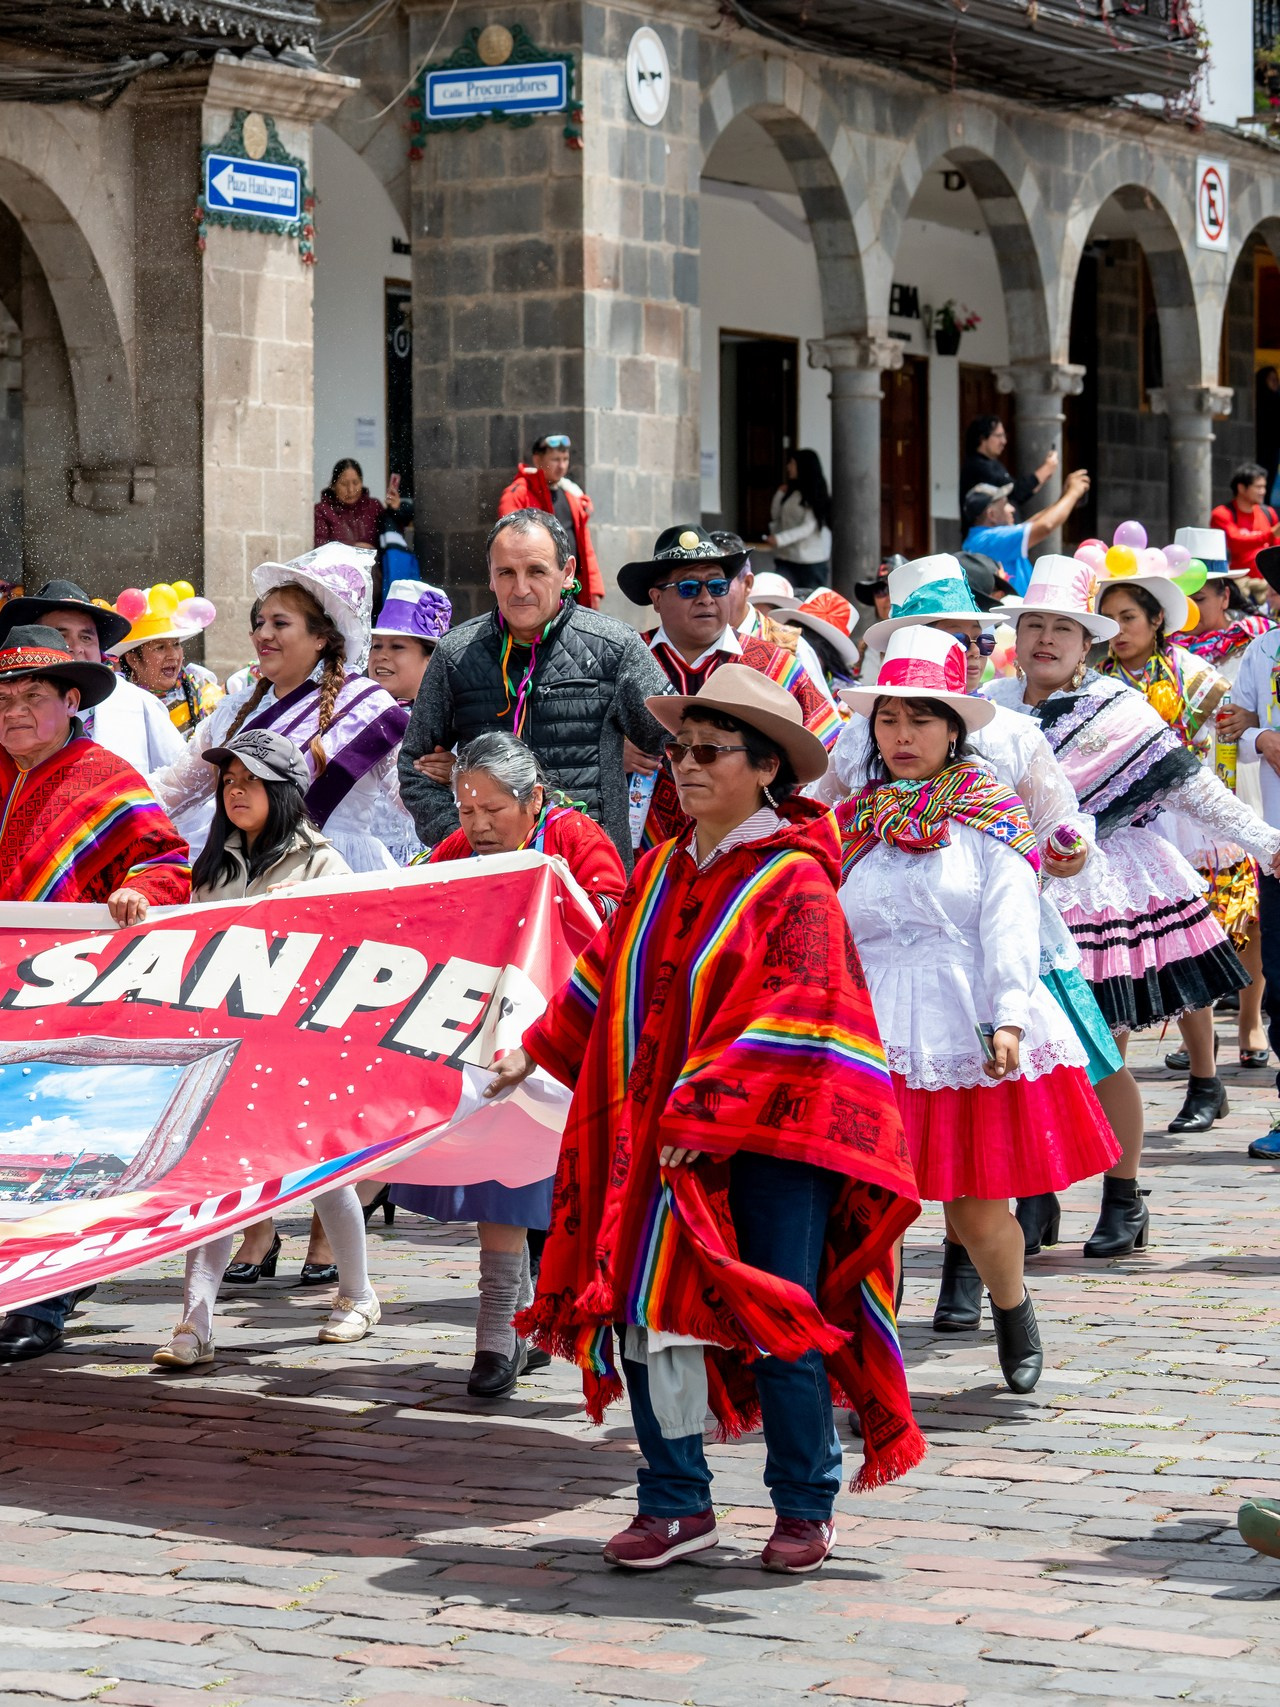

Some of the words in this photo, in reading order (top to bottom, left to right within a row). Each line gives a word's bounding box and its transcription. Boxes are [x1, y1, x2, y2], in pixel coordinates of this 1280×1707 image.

[442, 87, 464, 99] Calle
[466, 77, 548, 97] Procuradores
[226, 173, 248, 193] Plaza
[294, 939, 548, 1072] PED
